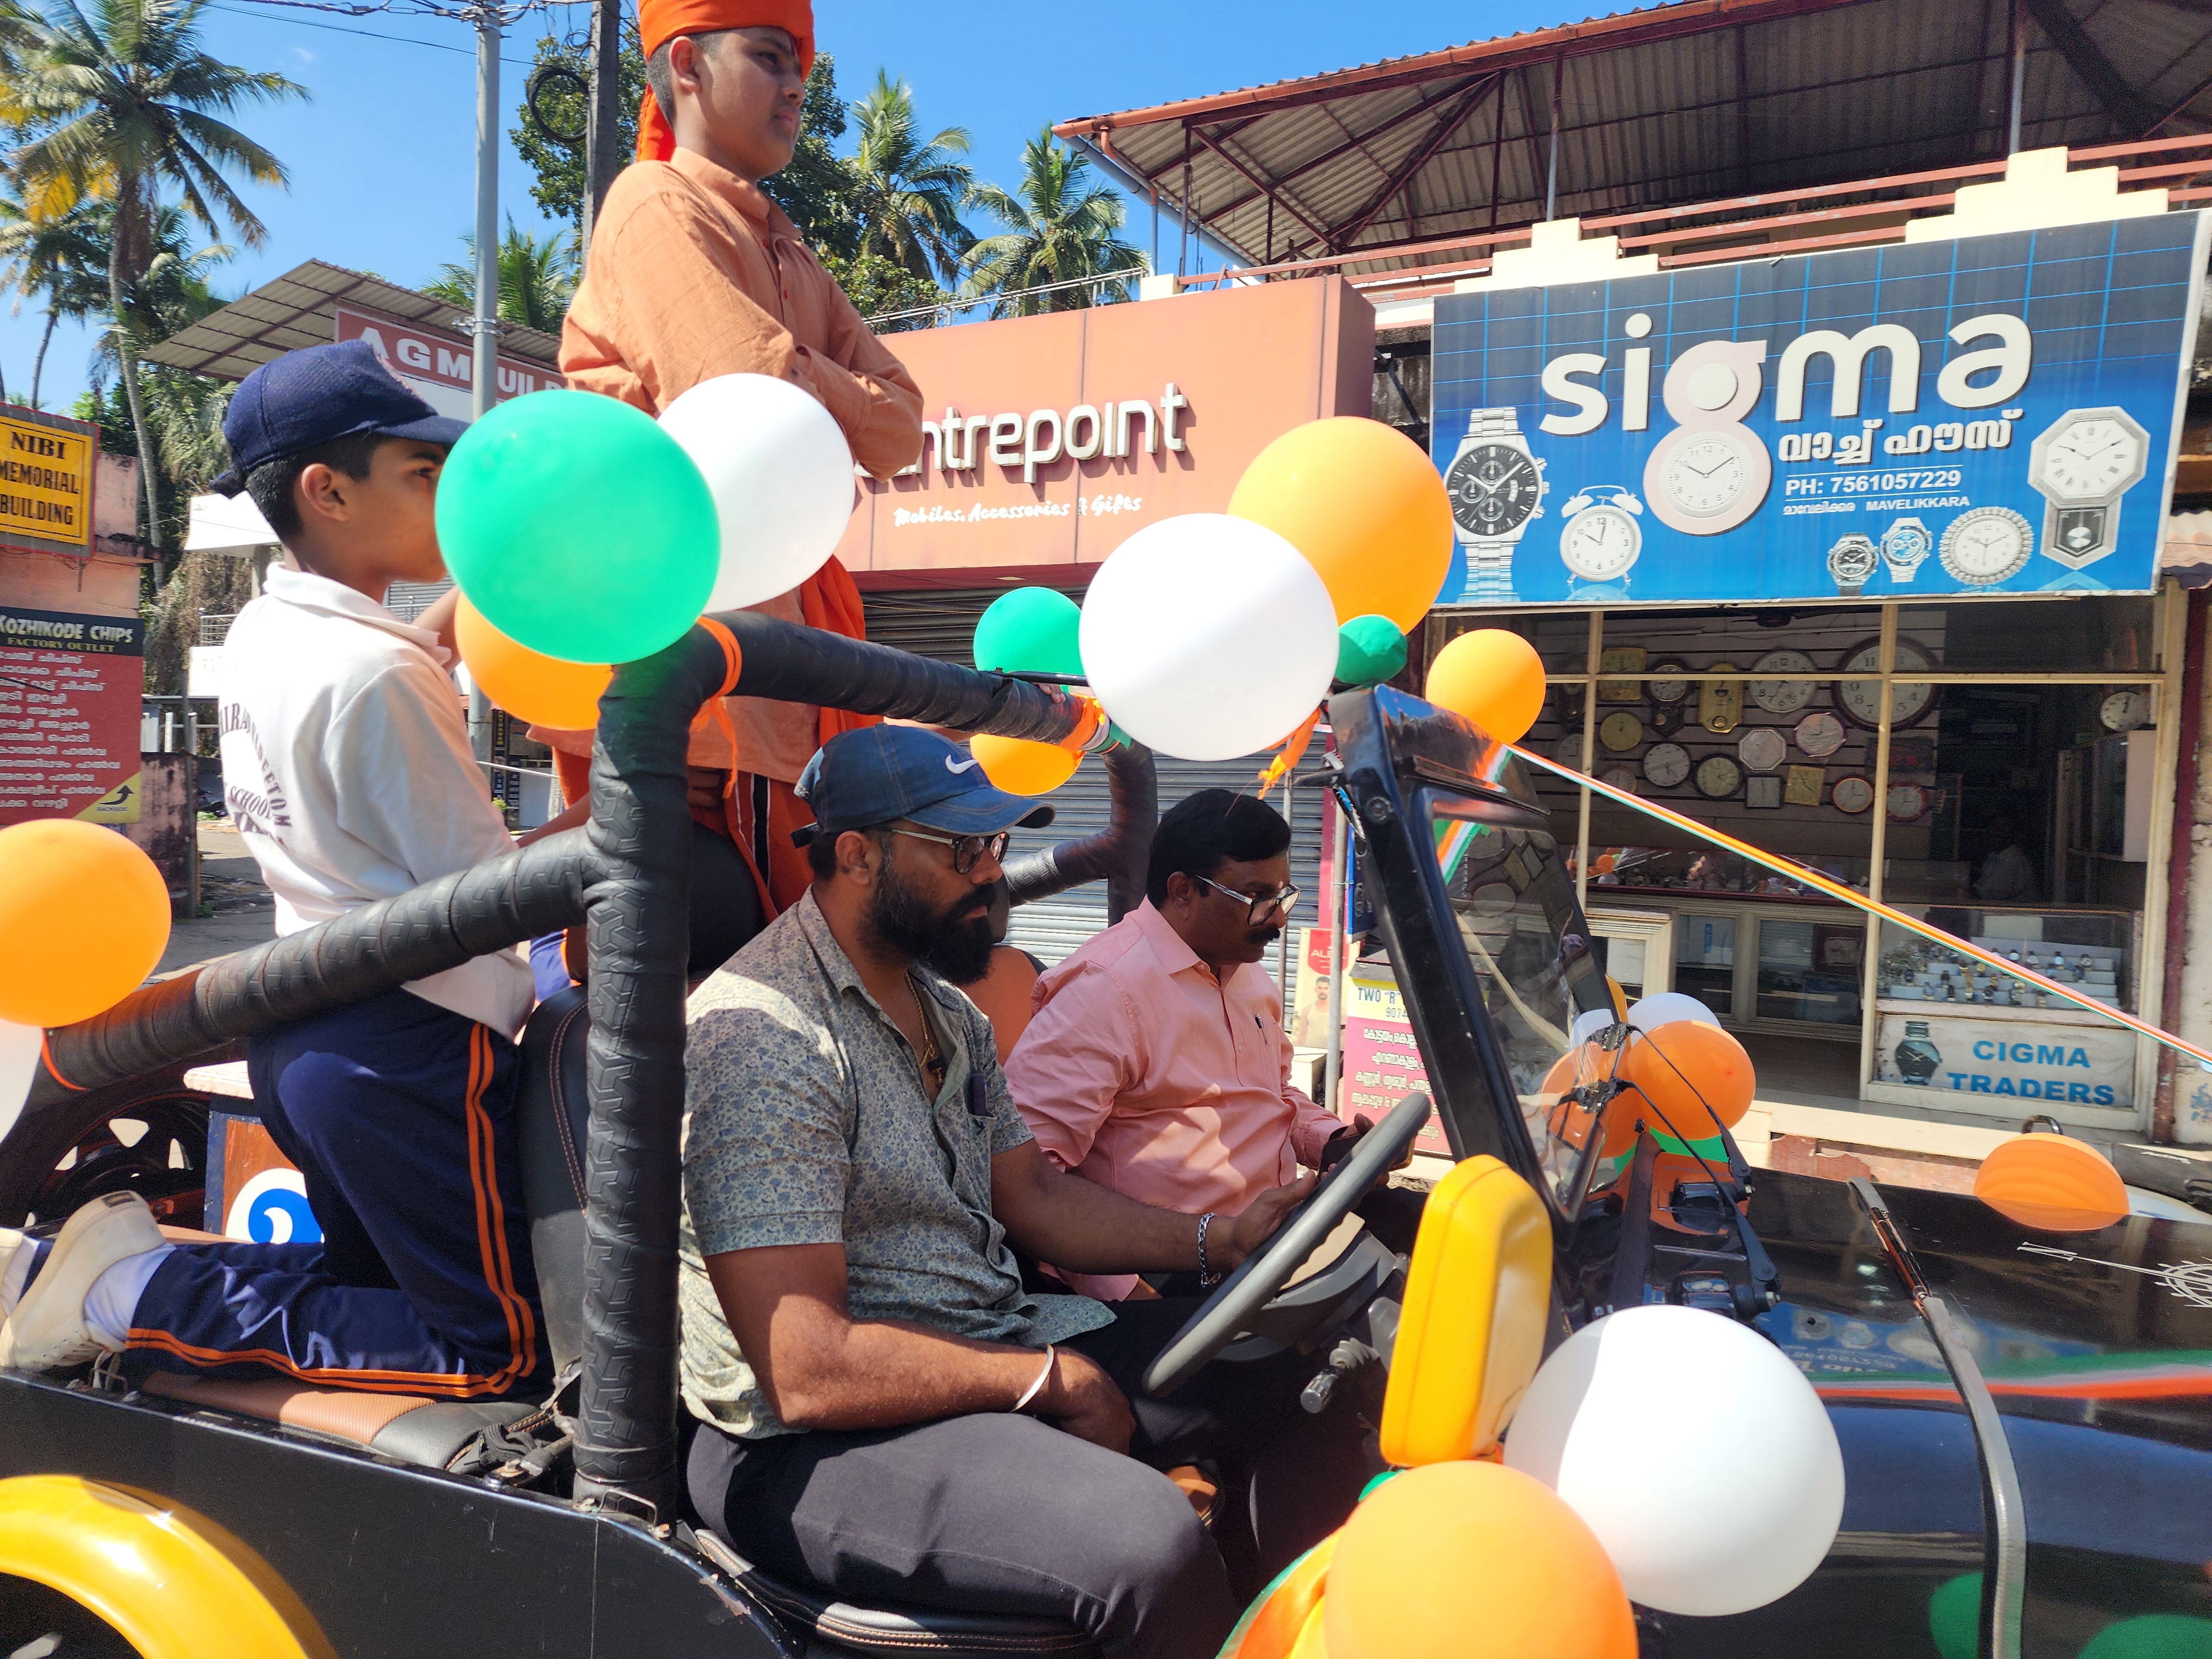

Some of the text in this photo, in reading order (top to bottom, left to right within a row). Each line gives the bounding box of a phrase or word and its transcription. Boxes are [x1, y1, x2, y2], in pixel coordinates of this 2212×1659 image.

[854, 383, 1188, 483] ntrepoint
[1539, 312, 2033, 536] sigma
[10, 431, 67, 460] NIBI
[1786, 469, 1961, 495] PH: 7561057229
[0, 493, 74, 525] BUILDING
[967, 499, 1071, 523] Accessories
[1091, 494, 1143, 516] Gifts
[1865, 497, 1970, 512] MAVELIKKARA
[7, 637, 115, 653] FACTORY OUTLET
[90, 625, 134, 643] CHIPS
[1358, 987, 1381, 1002] TWO
[1973, 1040, 2091, 1068] CIGMA
[1947, 1072, 2115, 1105] TRADERS
